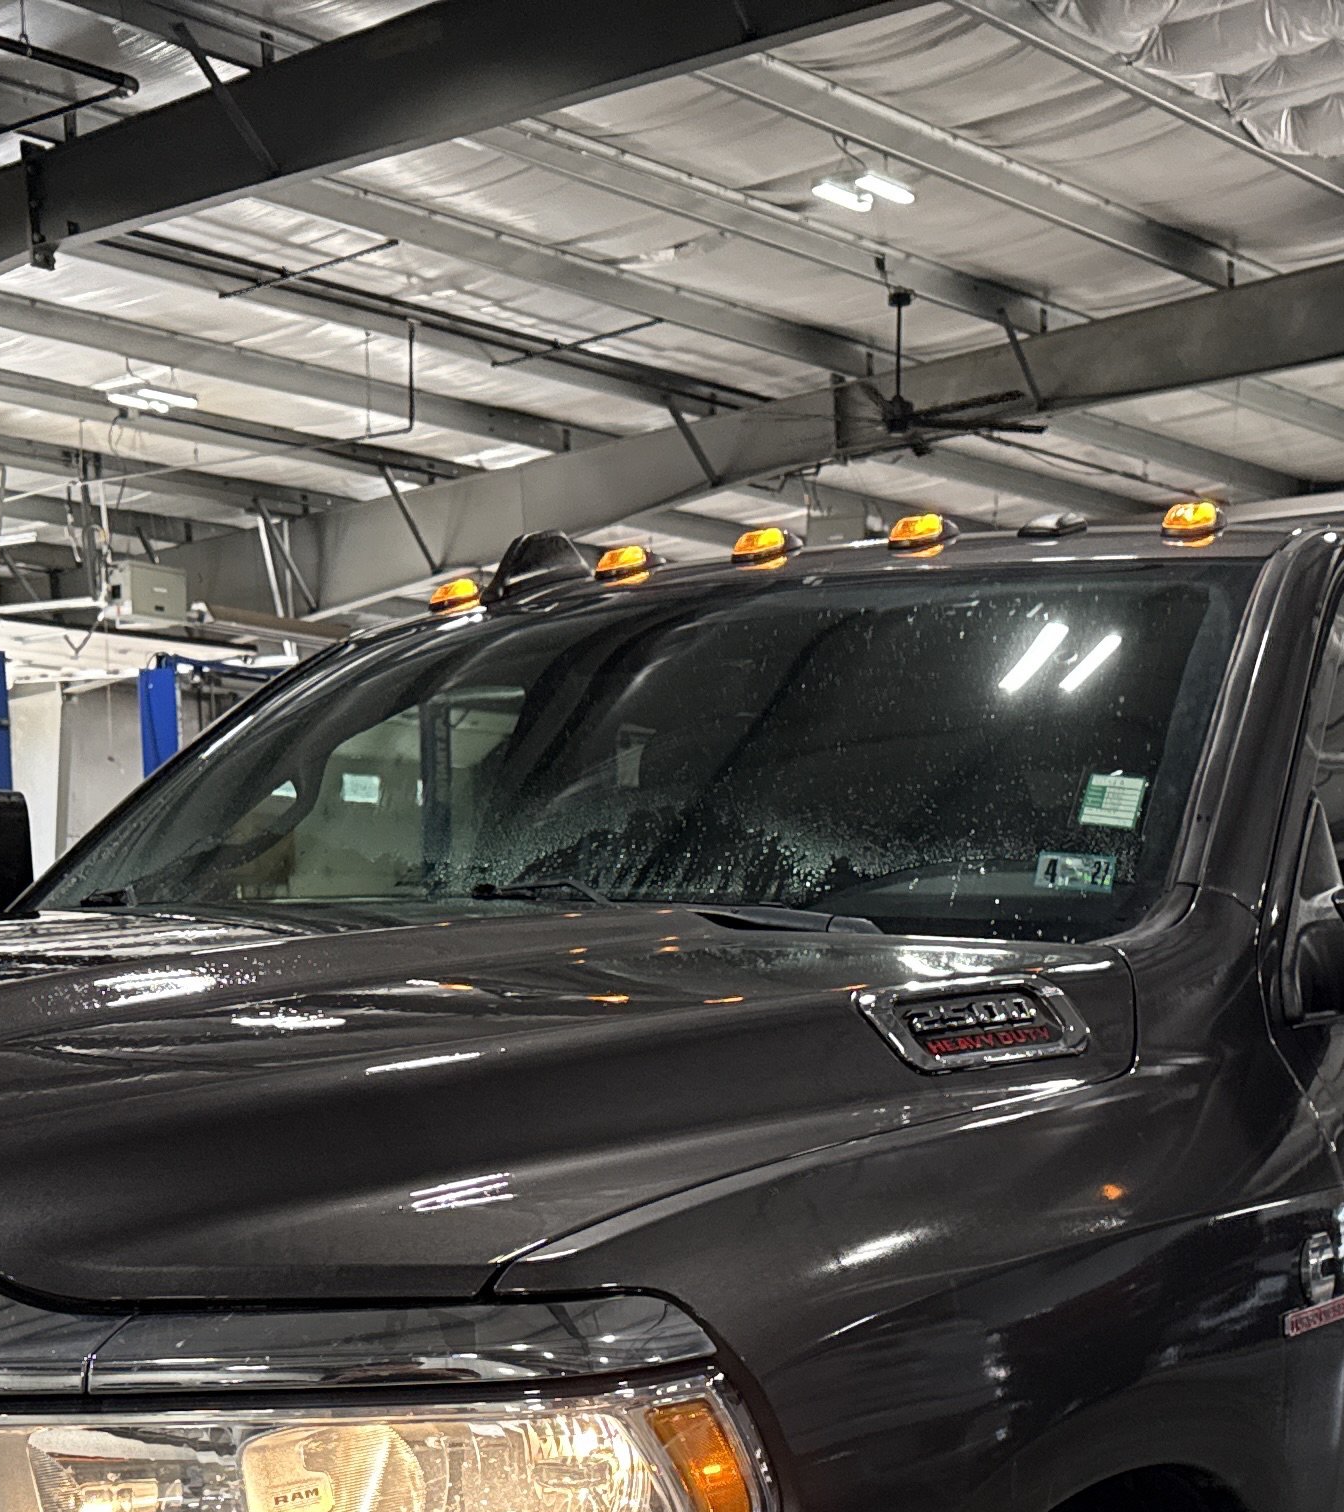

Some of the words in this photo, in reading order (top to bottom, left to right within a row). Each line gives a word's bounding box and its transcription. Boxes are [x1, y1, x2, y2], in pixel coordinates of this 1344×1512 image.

[905, 997, 1037, 1034] 2500
[926, 1031, 994, 1054] HEAVY
[999, 1026, 1050, 1045] DUTY
[273, 1487, 319, 1506] RAM
